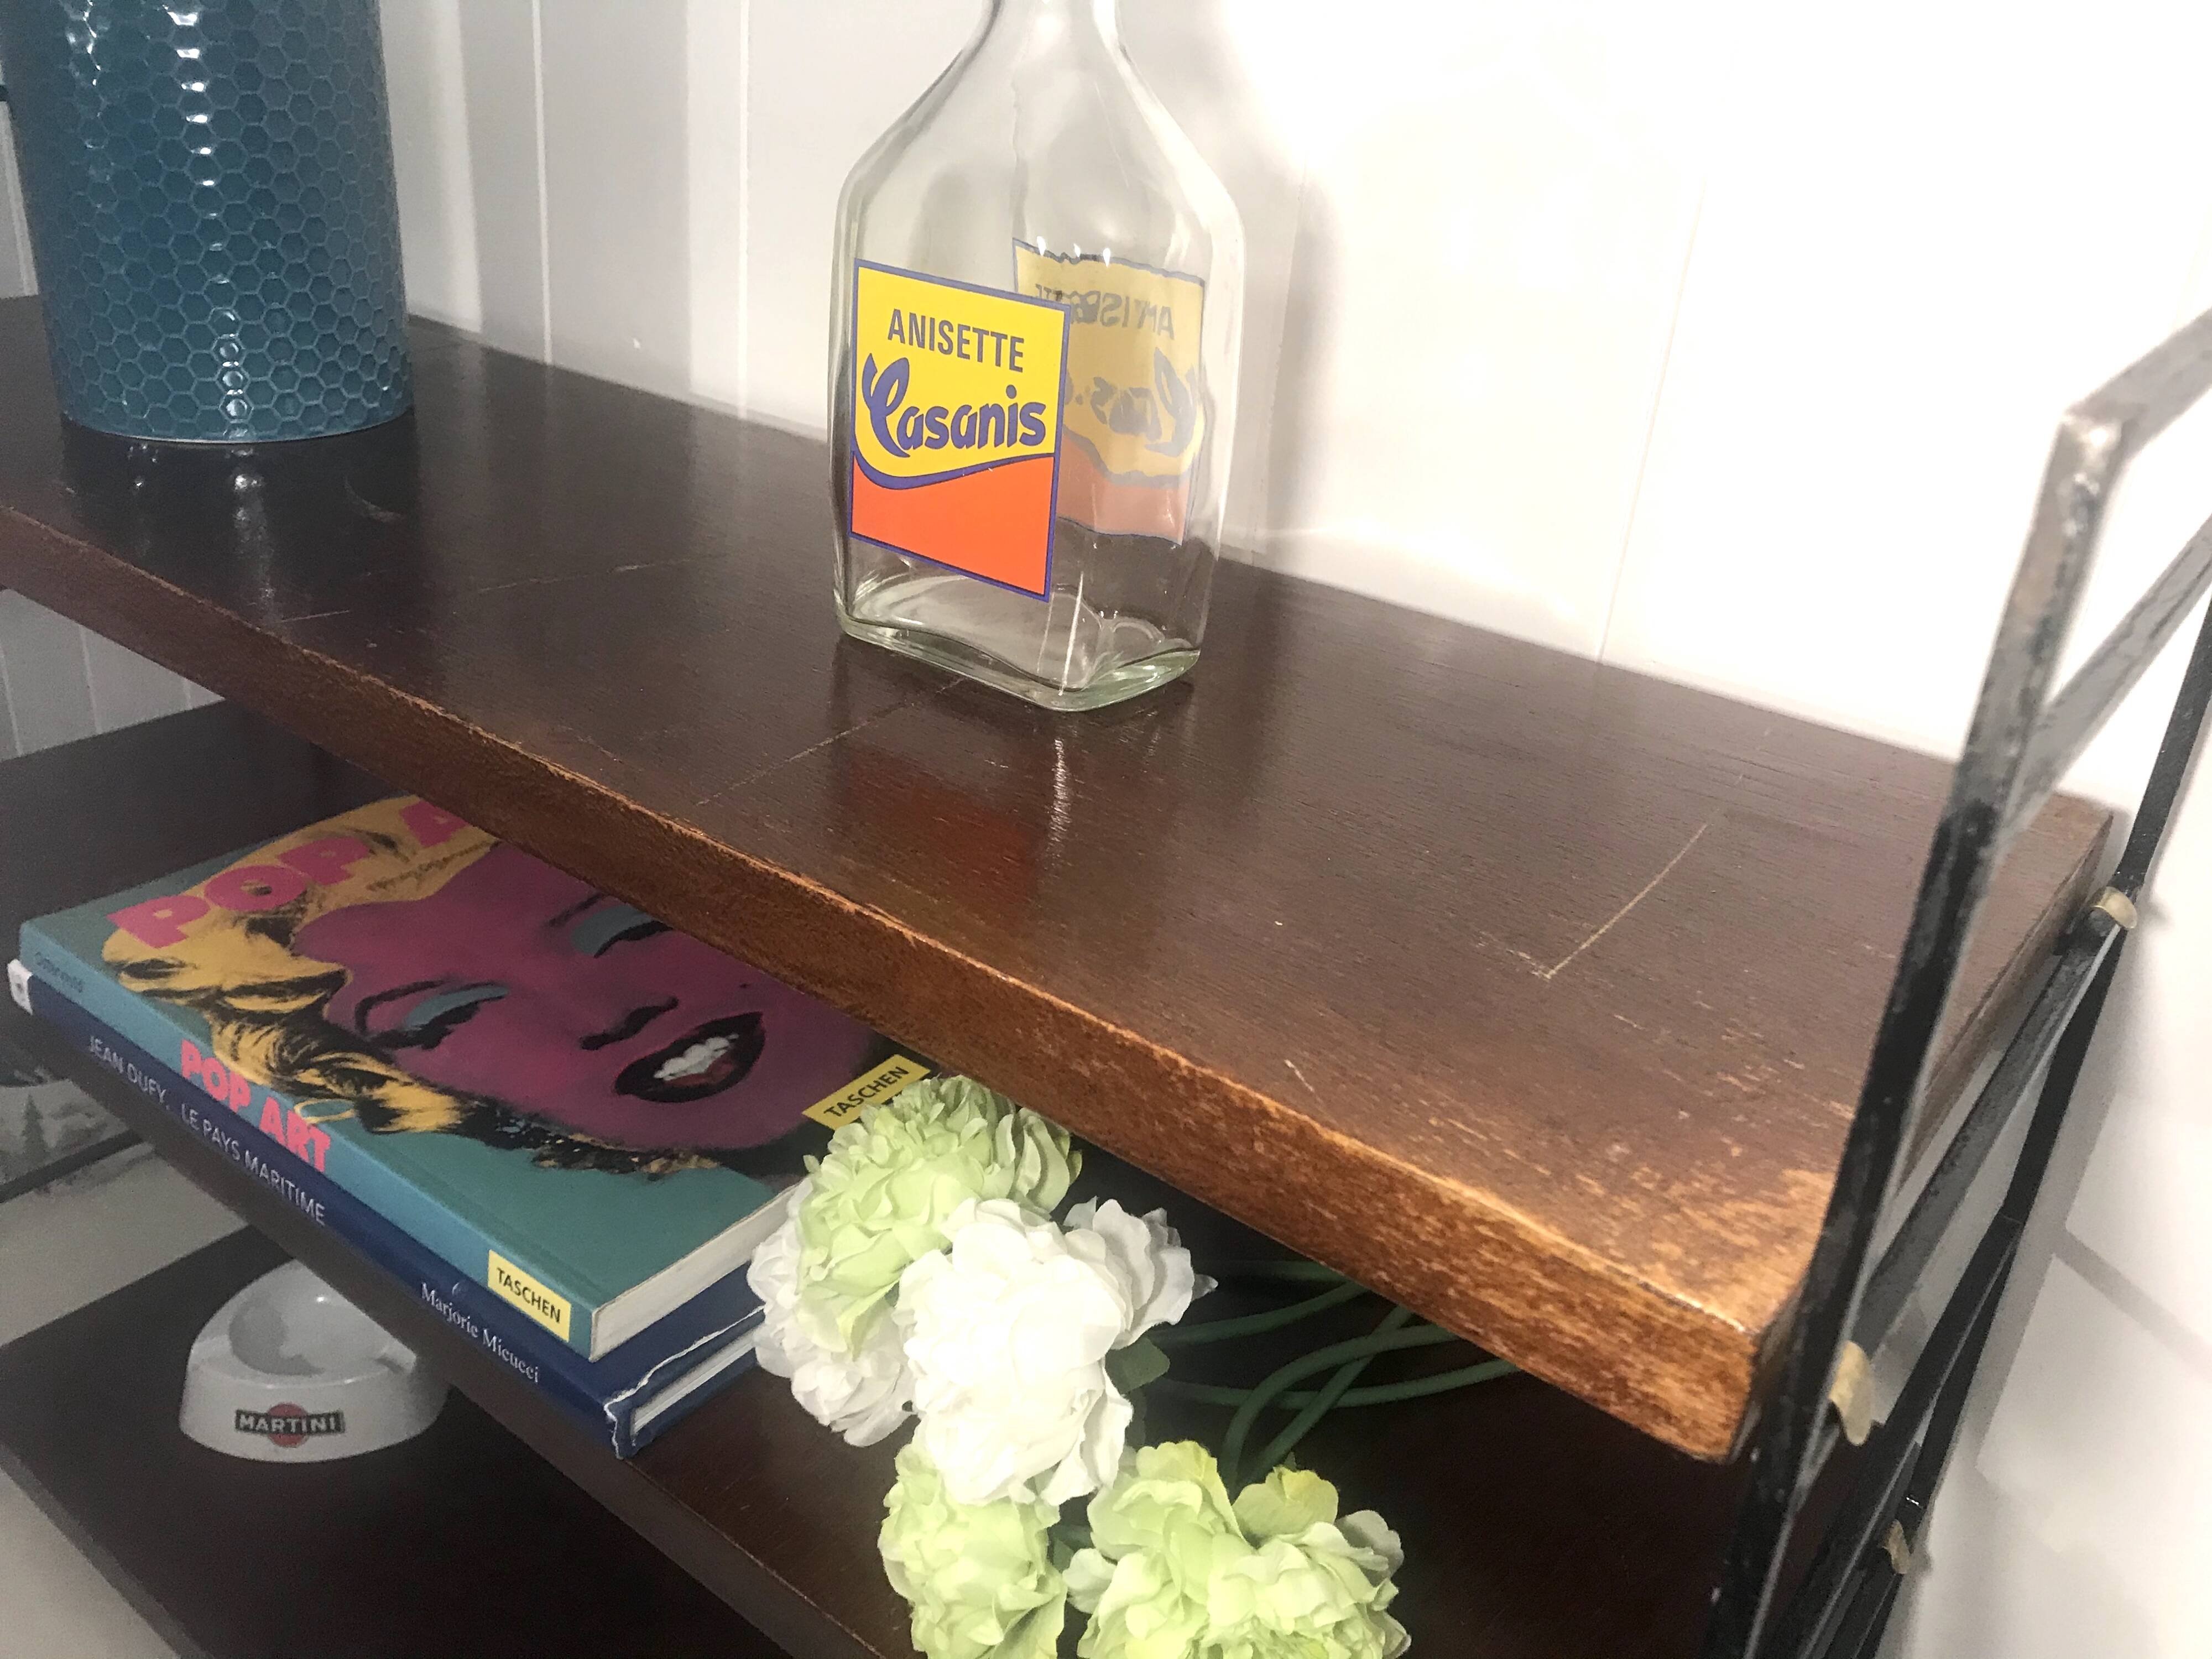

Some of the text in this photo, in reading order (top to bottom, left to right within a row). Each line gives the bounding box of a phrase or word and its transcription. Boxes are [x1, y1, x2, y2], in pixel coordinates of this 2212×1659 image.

[887, 309, 1025, 373] ANISETTE
[861, 352, 1046, 458] Casanis
[106, 836, 370, 948] POP
[89, 1036, 124, 1074] JEAN
[181, 1103, 200, 1131] LE
[203, 1119, 240, 1161] PAYS
[245, 1150, 326, 1226] MARITIME
[181, 1039, 331, 1173] POP ART
[823, 1066, 910, 1117] TASCHEN
[421, 1281, 539, 1383] Marjorie Micucci
[496, 1267, 561, 1323] TASCHEN
[239, 1413, 336, 1433] MARTINI
